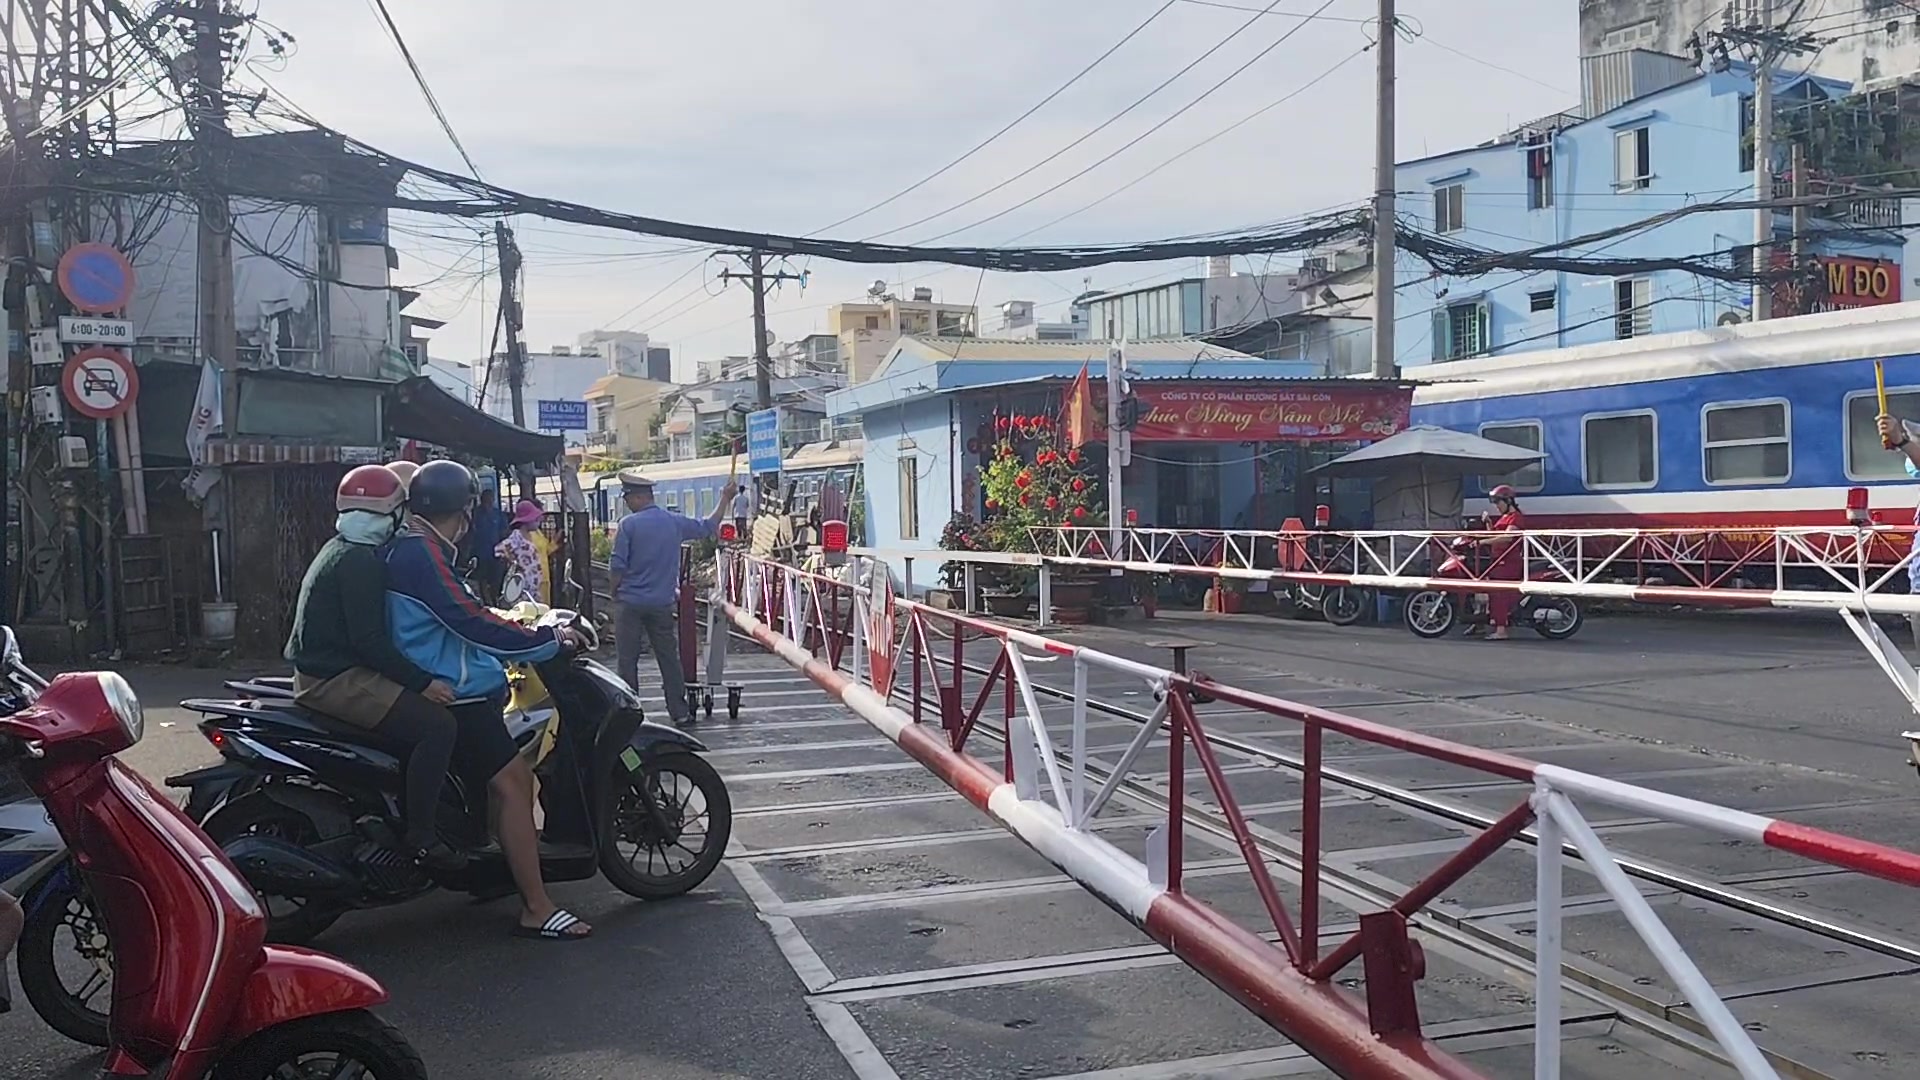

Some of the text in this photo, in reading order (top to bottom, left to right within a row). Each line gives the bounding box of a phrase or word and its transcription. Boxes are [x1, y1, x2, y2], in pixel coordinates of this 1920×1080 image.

[1853, 262, 1890, 298] ĐỎ
[1161, 389, 1188, 400] CÔNG
[1189, 391, 1201, 400] TY
[1143, 405, 1180, 424] húc
[1185, 402, 1253, 432] Mừng
[1259, 402, 1312, 424] Năm
[1318, 401, 1364, 424] Mới
